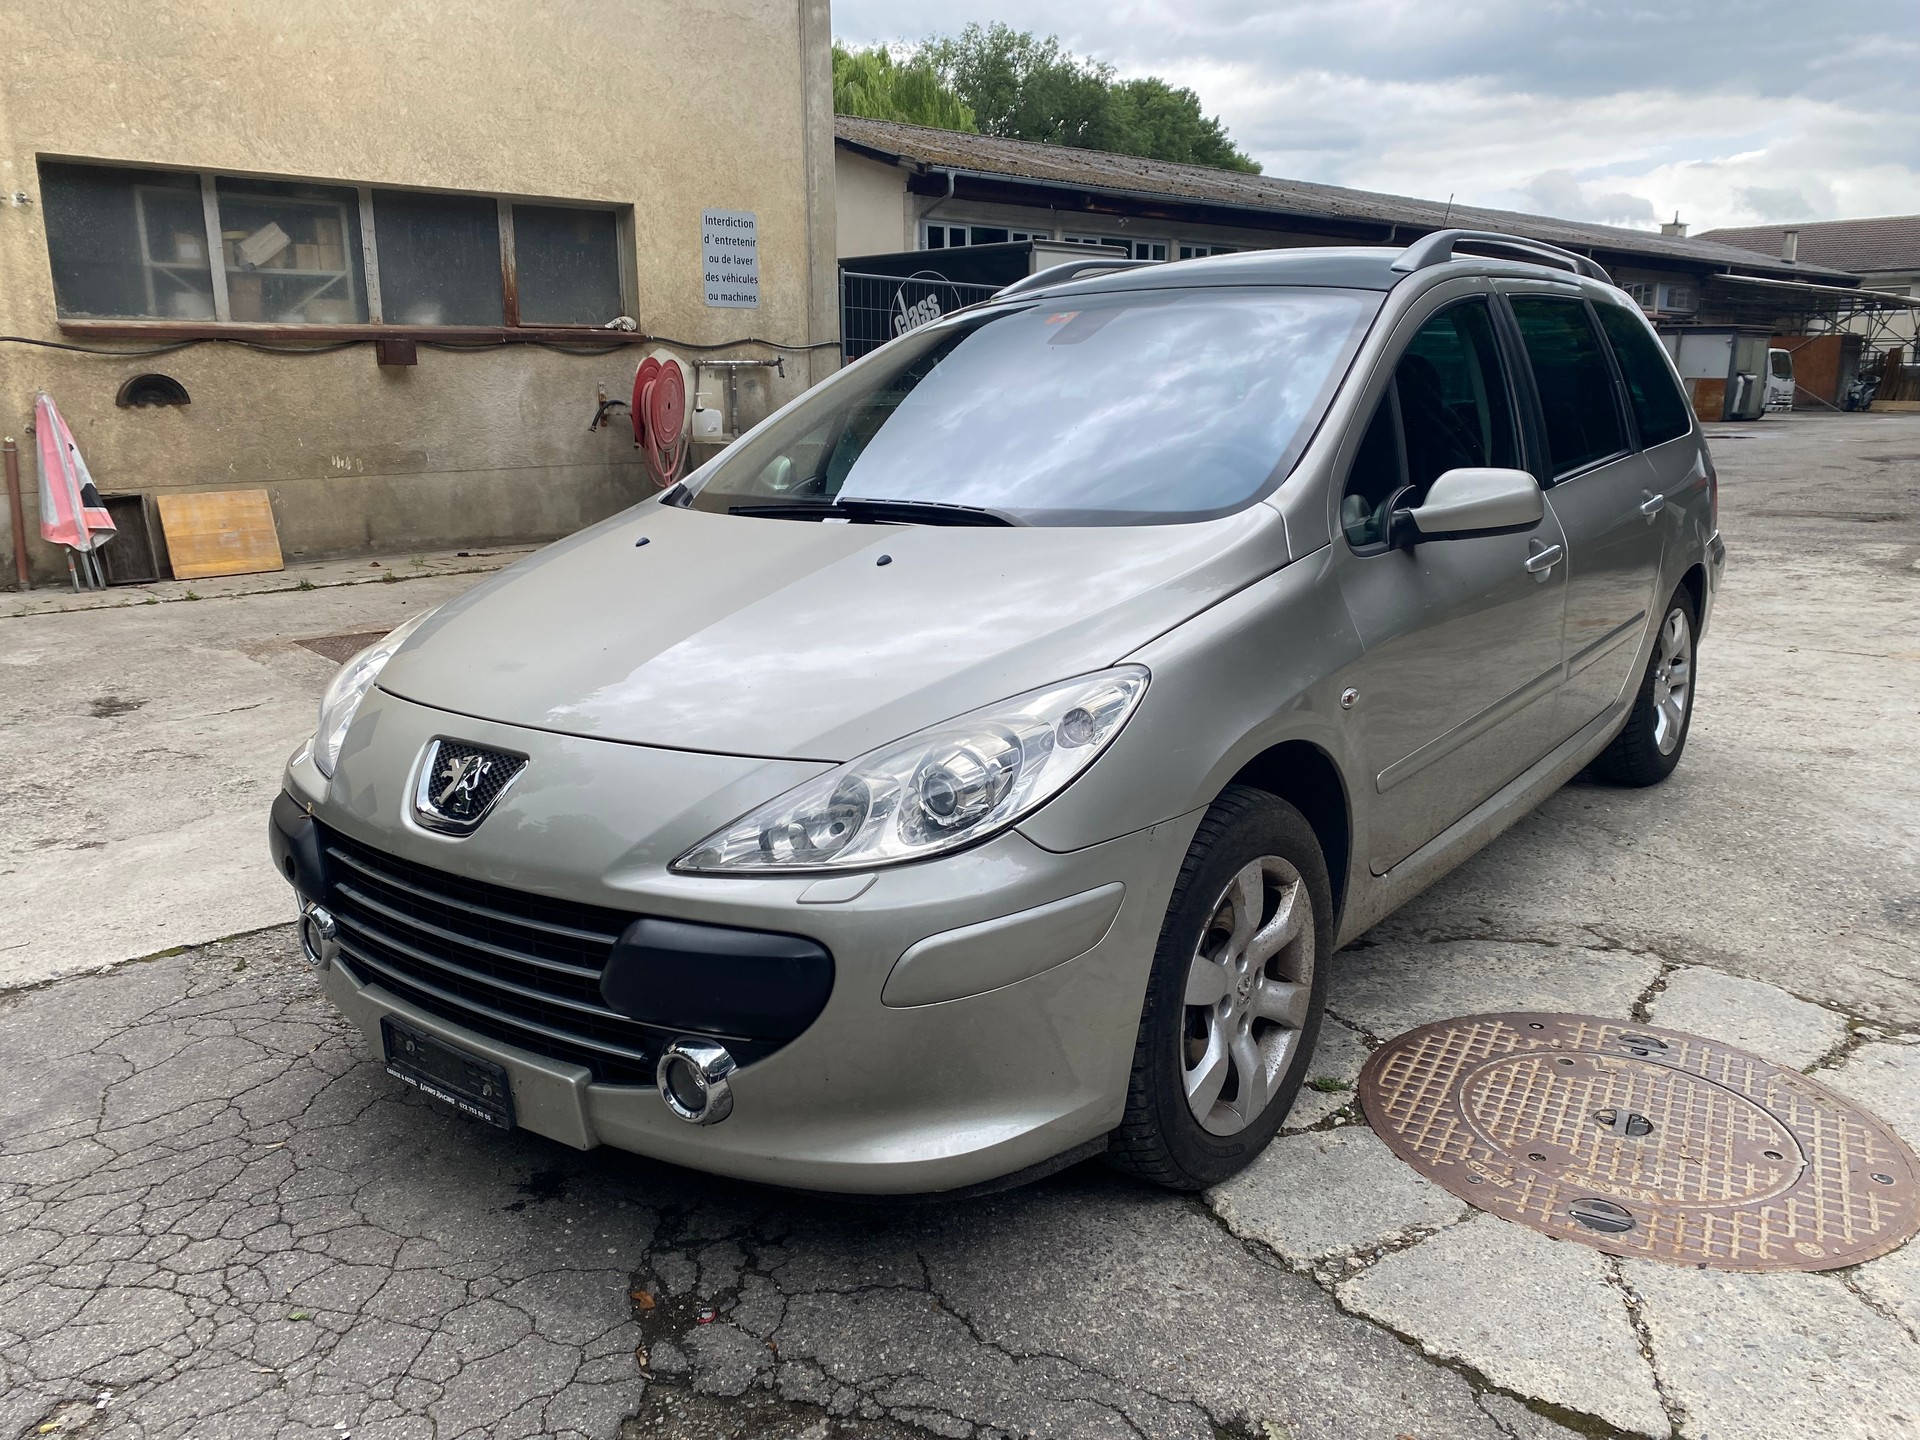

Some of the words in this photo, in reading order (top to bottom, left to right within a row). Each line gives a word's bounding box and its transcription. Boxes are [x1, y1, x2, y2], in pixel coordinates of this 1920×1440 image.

[705, 215, 754, 228] Interdiction
[709, 255, 719, 263] ou
[721, 254, 731, 264] de
[734, 255, 753, 265] laver
[705, 272, 719, 282] des
[721, 273, 758, 284] véhicules
[721, 292, 757, 302] machines
[894, 289, 940, 336] class
